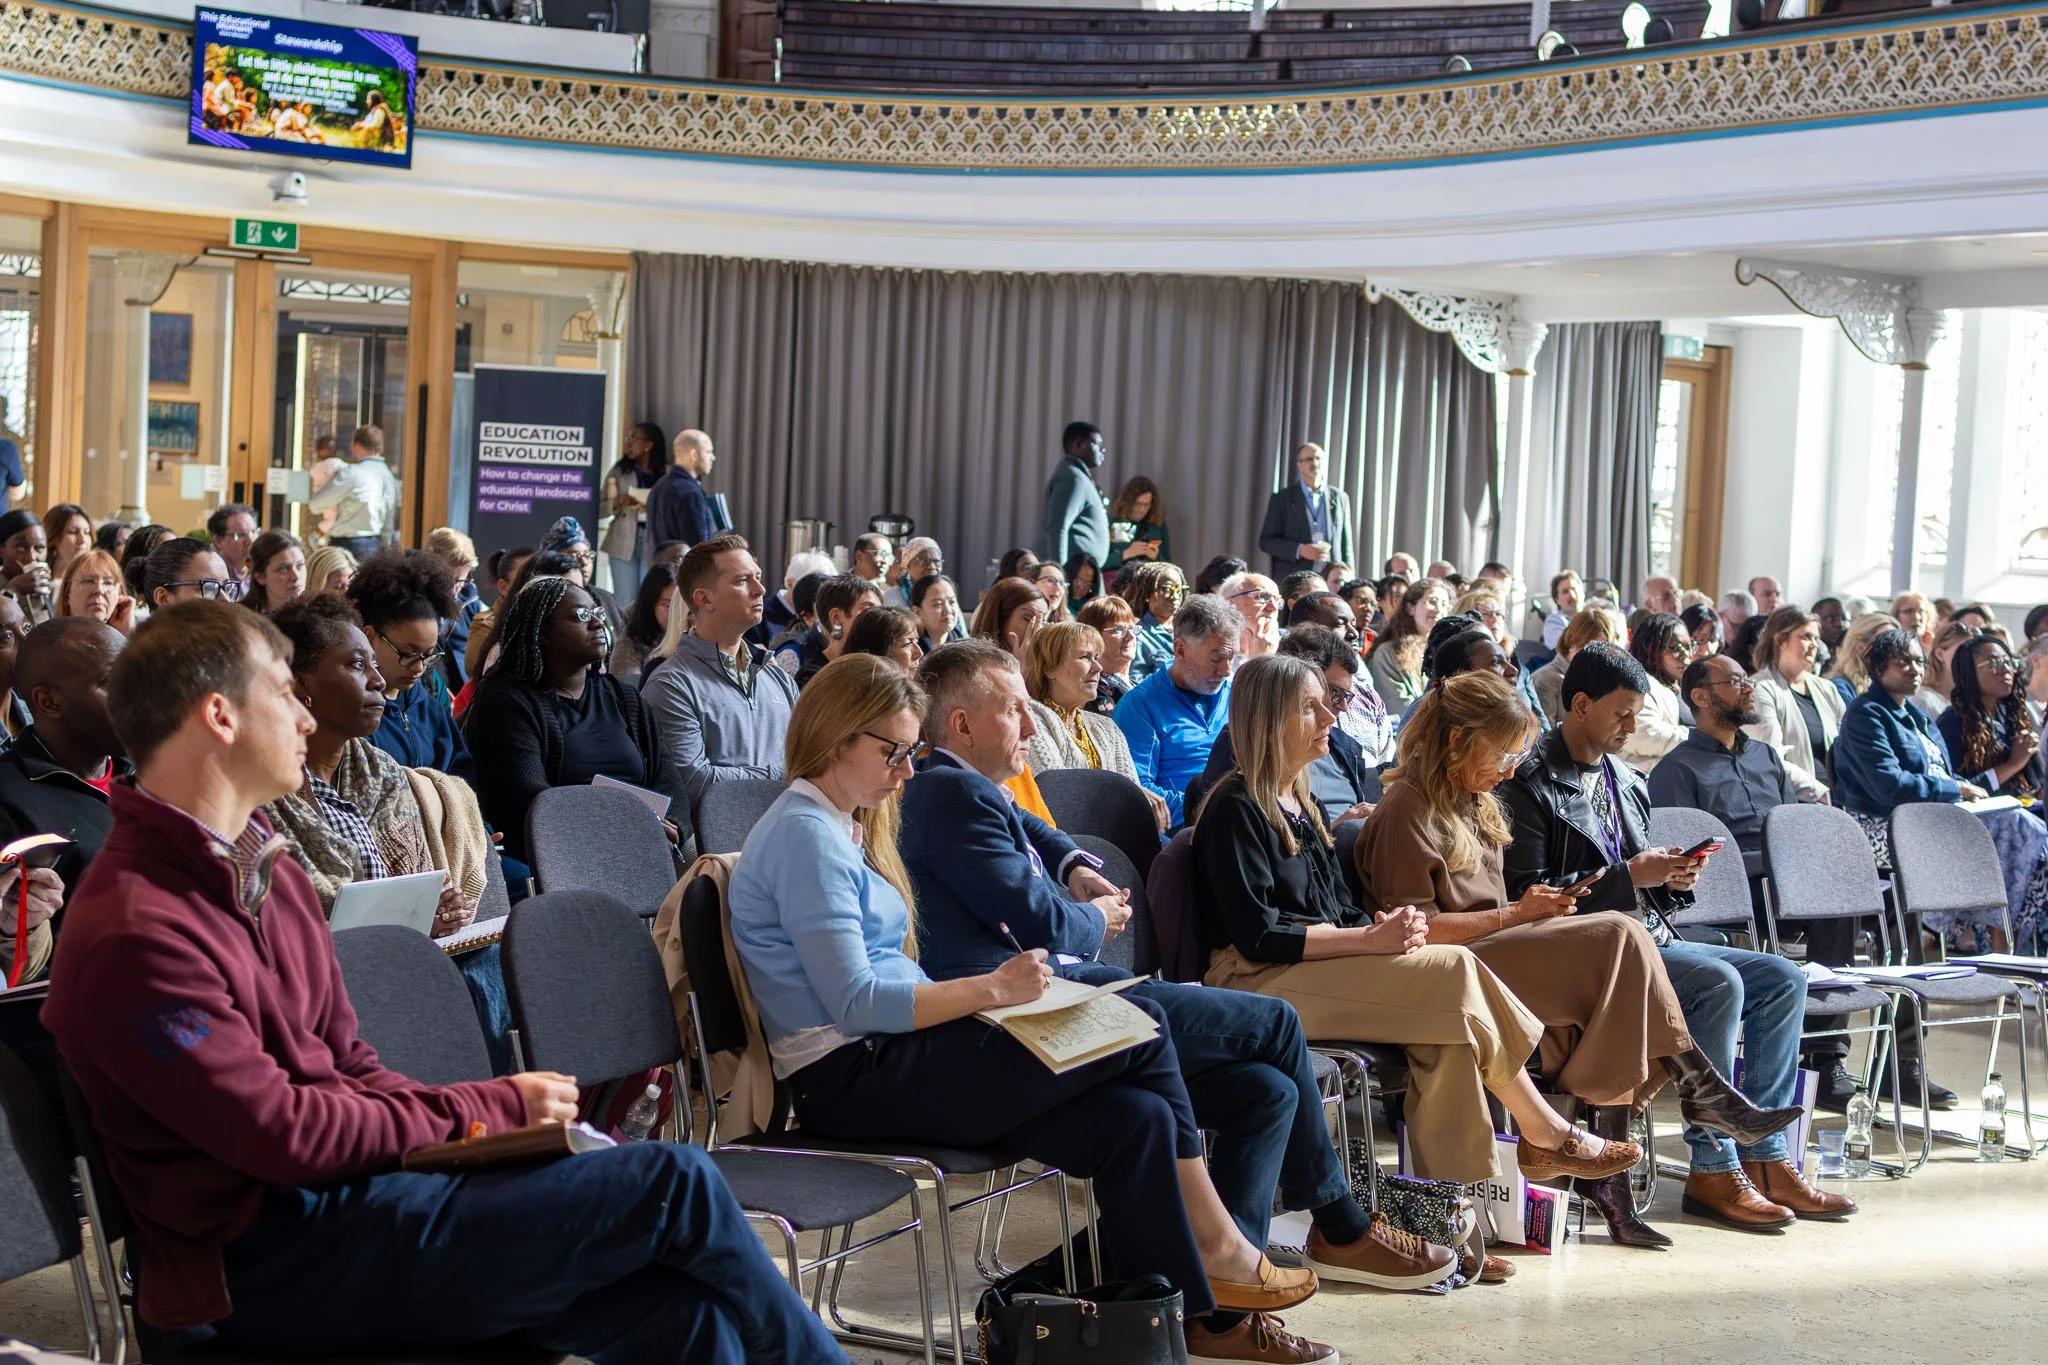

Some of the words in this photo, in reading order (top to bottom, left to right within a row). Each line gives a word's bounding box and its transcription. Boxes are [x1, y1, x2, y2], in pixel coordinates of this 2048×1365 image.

[199, 11, 219, 23] This
[219, 14, 270, 31] Educational
[274, 33, 343, 55] Stewardship
[238, 53, 253, 68] Let
[253, 56, 269, 70] the
[270, 57, 293, 73] little
[293, 61, 329, 78] children
[329, 68, 353, 81] come
[353, 69, 364, 82] to
[263, 71, 281, 83] and
[281, 72, 293, 85] do
[294, 75, 309, 87] not
[483, 426, 580, 442] EDUCATION
[483, 446, 588, 462] REVOLUTION
[480, 468, 505, 479] How
[507, 470, 519, 480] to
[521, 469, 560, 484] change
[562, 472, 581, 483] the
[480, 484, 533, 497] education
[535, 487, 589, 500] landscape
[480, 500, 495, 510] for
[497, 501, 529, 512] Christ
[1267, 1244, 1307, 1255] ERV
